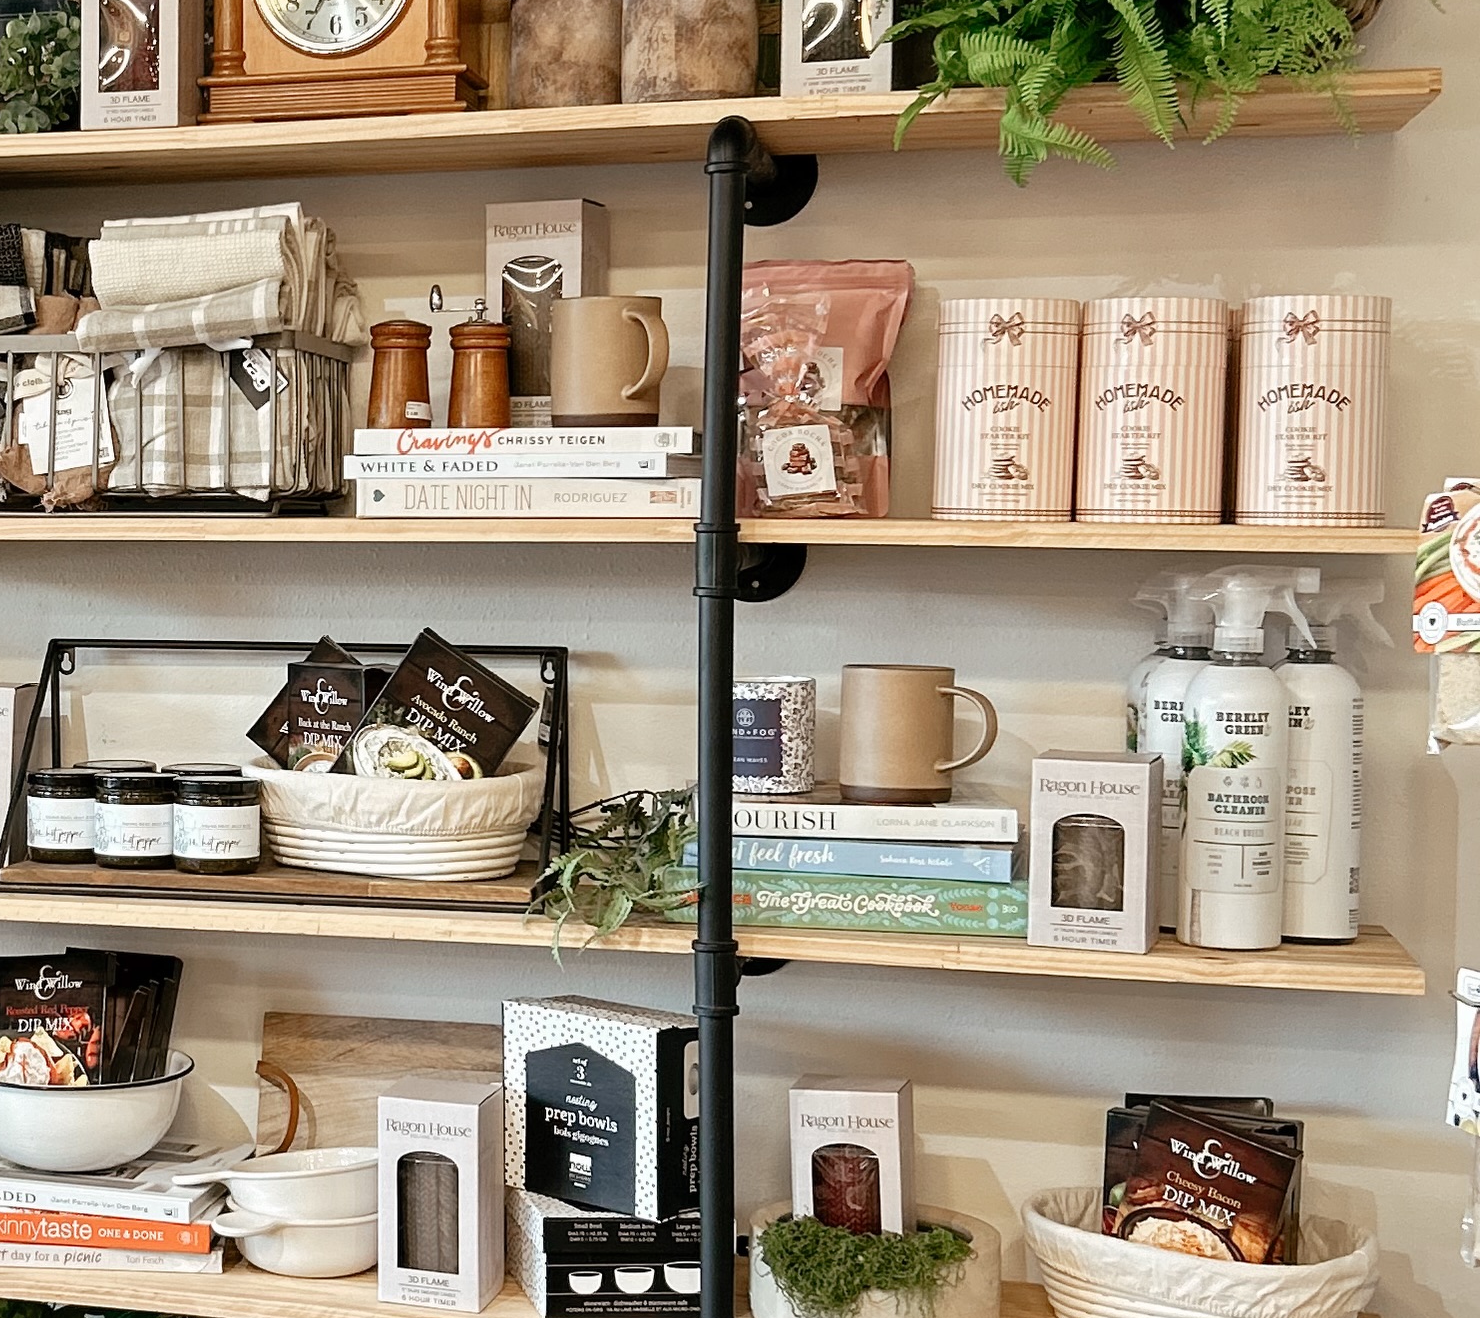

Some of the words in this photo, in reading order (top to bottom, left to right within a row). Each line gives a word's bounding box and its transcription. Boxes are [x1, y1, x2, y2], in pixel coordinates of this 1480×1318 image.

[330, 14, 343, 36] 6
[355, 6, 368, 28] 5
[123, 93, 152, 103] FLAME
[961, 384, 1052, 413] HOMEMADE
[1095, 383, 1186, 412] HOMEMADE
[1257, 383, 1352, 413] HOMEMADE
[397, 428, 510, 455] Cravings
[498, 435, 554, 446] CHRISSY
[559, 435, 606, 446] TEIGEN
[360, 461, 416, 475] WHITE
[423, 460, 436, 473] &
[442, 459, 498, 473] FADED
[404, 485, 450, 511] DATE
[455, 485, 508, 511] NIGHT
[514, 484, 533, 510] IN
[553, 491, 628, 505] RODRIGUEZ
[410, 694, 448, 724] Avocado
[448, 718, 478, 745] Ranch
[405, 707, 435, 732] DIP
[432, 726, 467, 754] MIX
[1224, 724, 1264, 736] GREEN
[1039, 778, 1086, 796] Ragon
[1090, 780, 1141, 796] House
[1207, 792, 1270, 805] BATHROOM
[1213, 804, 1266, 816] CLEANER
[749, 838, 785, 864] feel
[788, 841, 838, 869] fresh
[756, 890, 789, 911] The
[788, 889, 850, 916] Great
[852, 893, 941, 920] Cookbook
[1061, 914, 1074, 923] 3D
[1076, 914, 1111, 925] FLAME
[5, 1004, 39, 1016] Roasted
[41, 1004, 58, 1016] Red
[59, 1003, 90, 1019] Pepper
[17, 1018, 43, 1033] DIP
[45, 1017, 74, 1033] MIX
[565, 1094, 598, 1112] nesting
[385, 1116, 424, 1136] Ragon
[428, 1119, 472, 1136] House
[544, 1106, 577, 1127] prep
[578, 1110, 618, 1133] bowls
[800, 1113, 845, 1131] Ragon
[847, 1115, 895, 1130] House
[553, 1124, 572, 1138] bols
[1166, 1170, 1206, 1196] Cheesy
[1207, 1189, 1242, 1211] Bacon
[1162, 1184, 1195, 1210] DIP
[1199, 1198, 1237, 1227] MIX
[97, 1228, 121, 1239] ONE
[133, 1229, 165, 1241] DONE
[10, 1248, 32, 1263] day
[34, 1248, 52, 1261] for
[63, 1251, 103, 1266] picnic
[407, 1274, 419, 1284] 3D
[421, 1276, 450, 1288] FLAME
